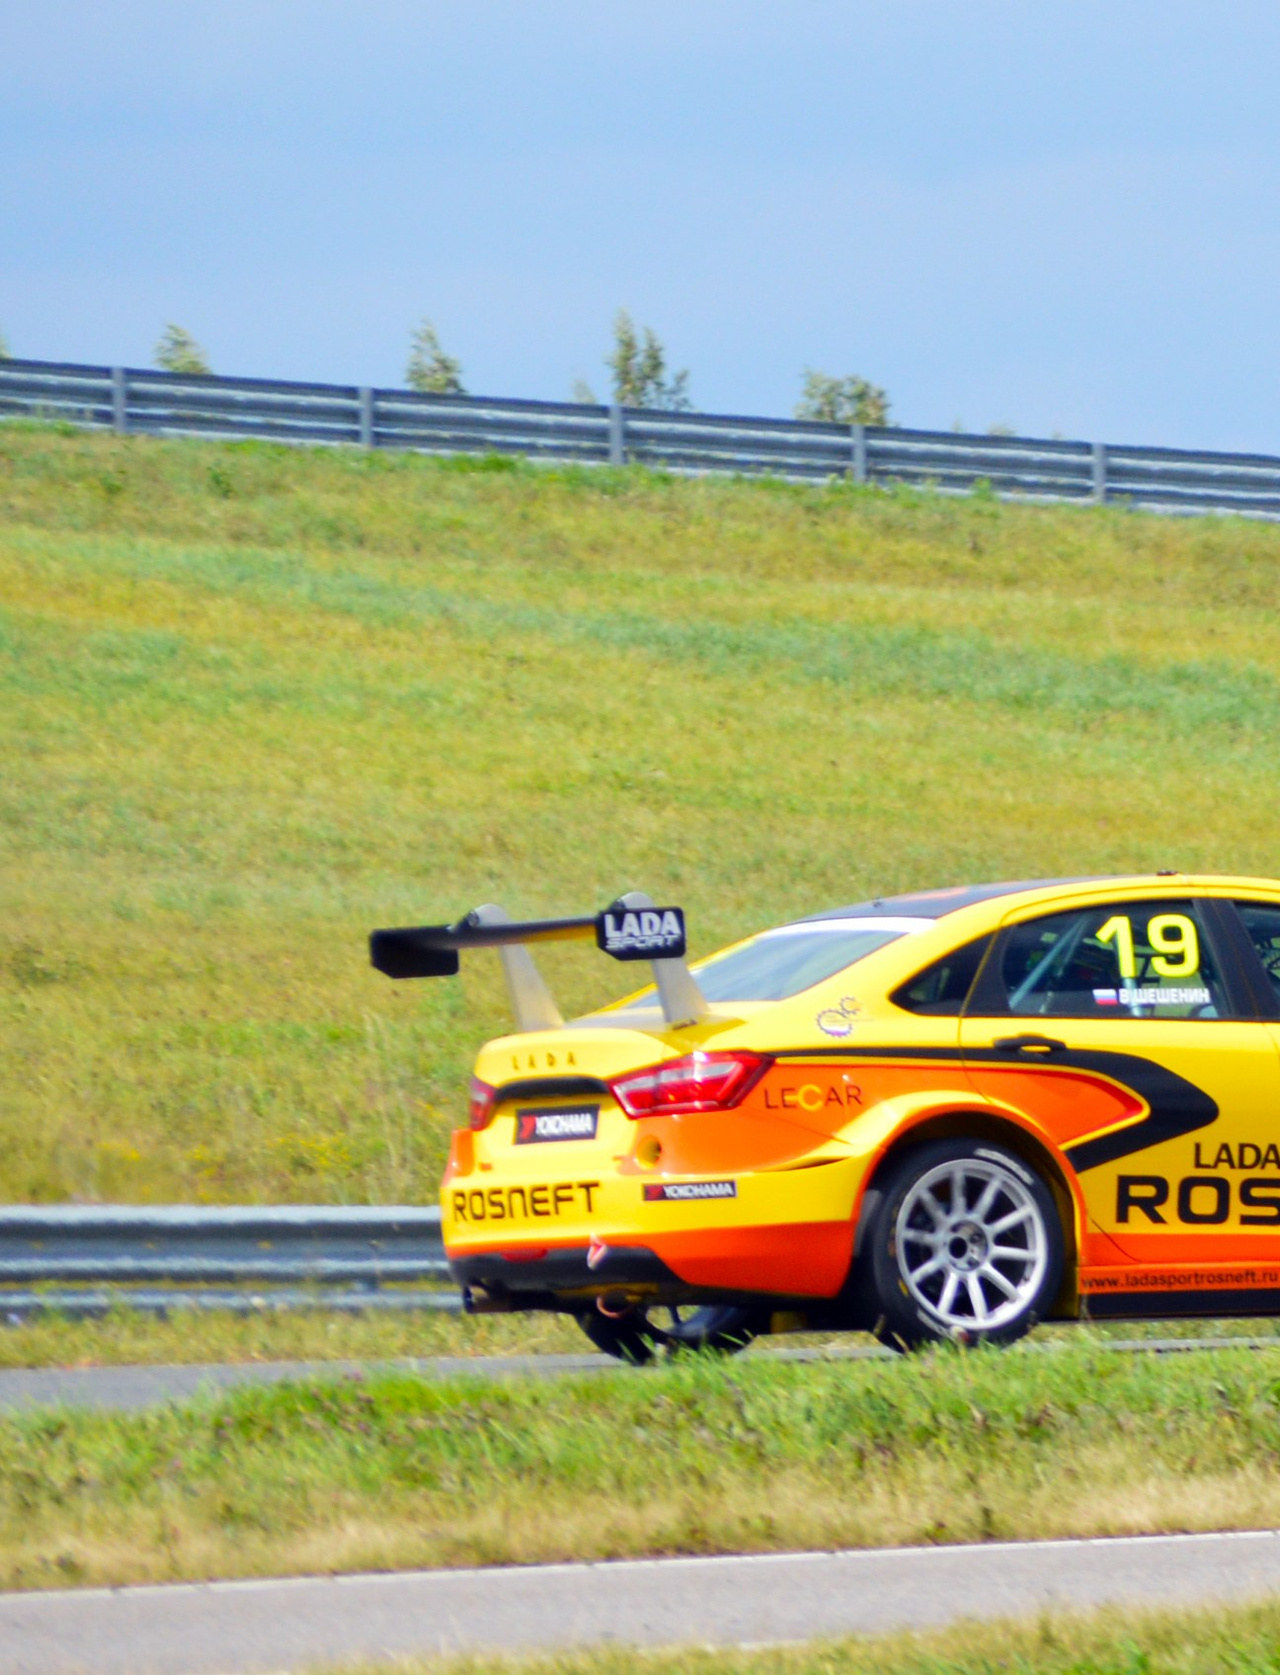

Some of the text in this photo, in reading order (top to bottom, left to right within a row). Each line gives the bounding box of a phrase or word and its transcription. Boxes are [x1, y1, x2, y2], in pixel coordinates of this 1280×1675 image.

[604, 911, 681, 938] LADA
[605, 934, 679, 951] SPORT
[1095, 914, 1199, 978] 19
[512, 1052, 577, 1071] LADA
[764, 1084, 862, 1112] LECAR
[662, 1182, 735, 1198] YOKOHAMA
[453, 1181, 600, 1223] ROSNEFT
[1081, 1270, 1279, 1288] www.ladasportrosneft.ru
